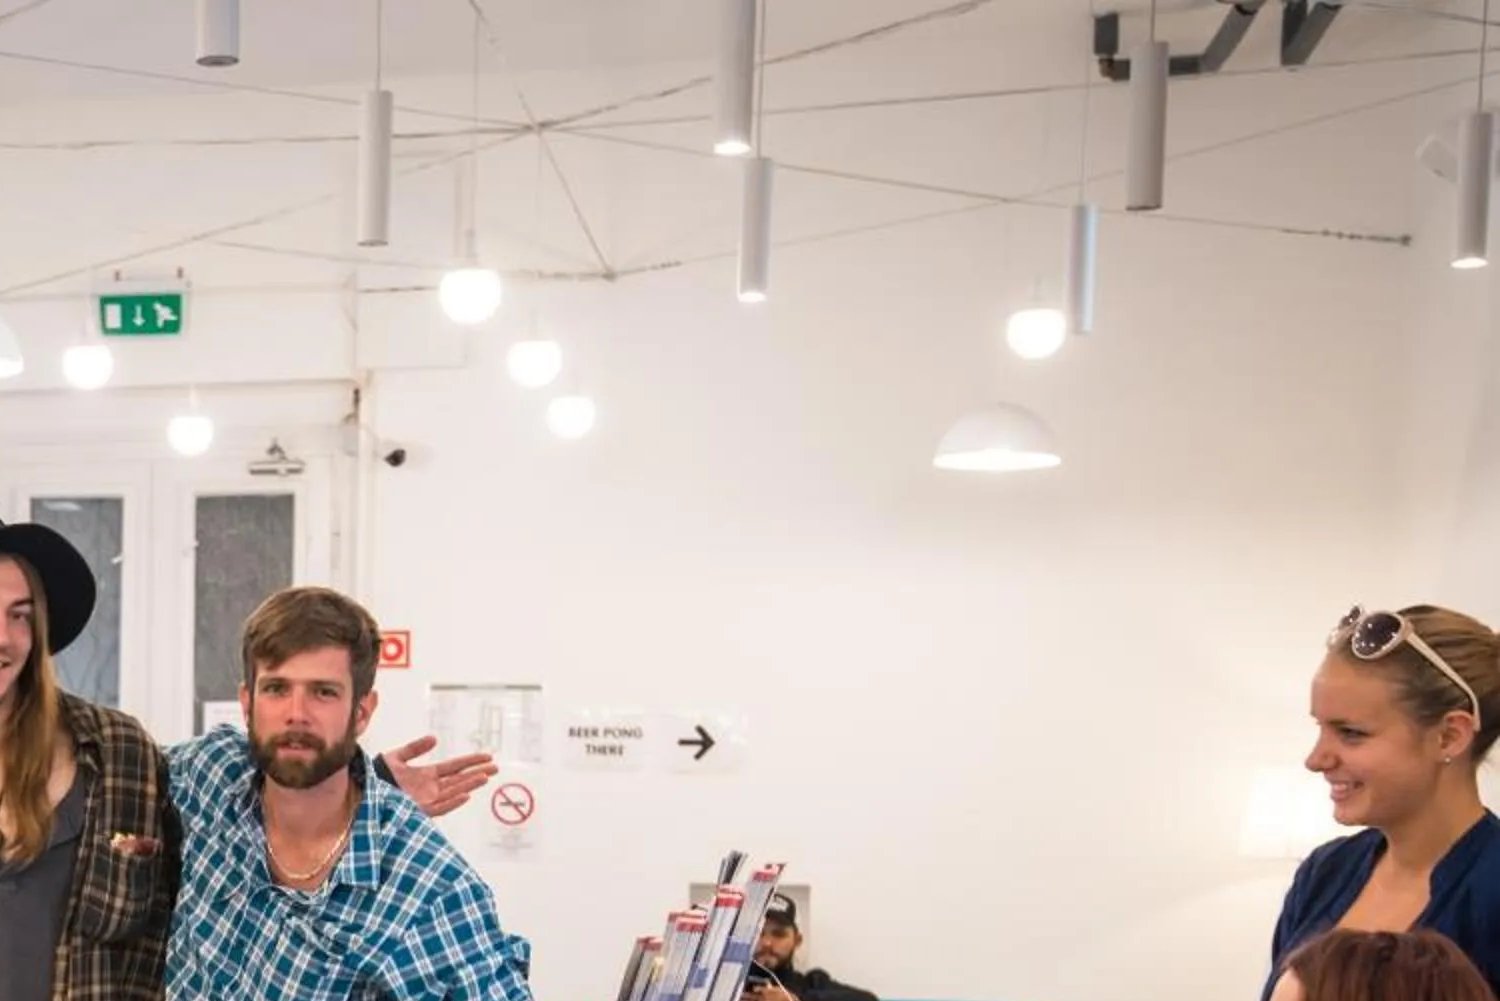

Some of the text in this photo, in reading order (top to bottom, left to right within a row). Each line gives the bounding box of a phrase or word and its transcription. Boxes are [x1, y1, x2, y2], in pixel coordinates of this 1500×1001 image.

[568, 727, 643, 739] BEER PONG
[585, 744, 624, 756] THERE
